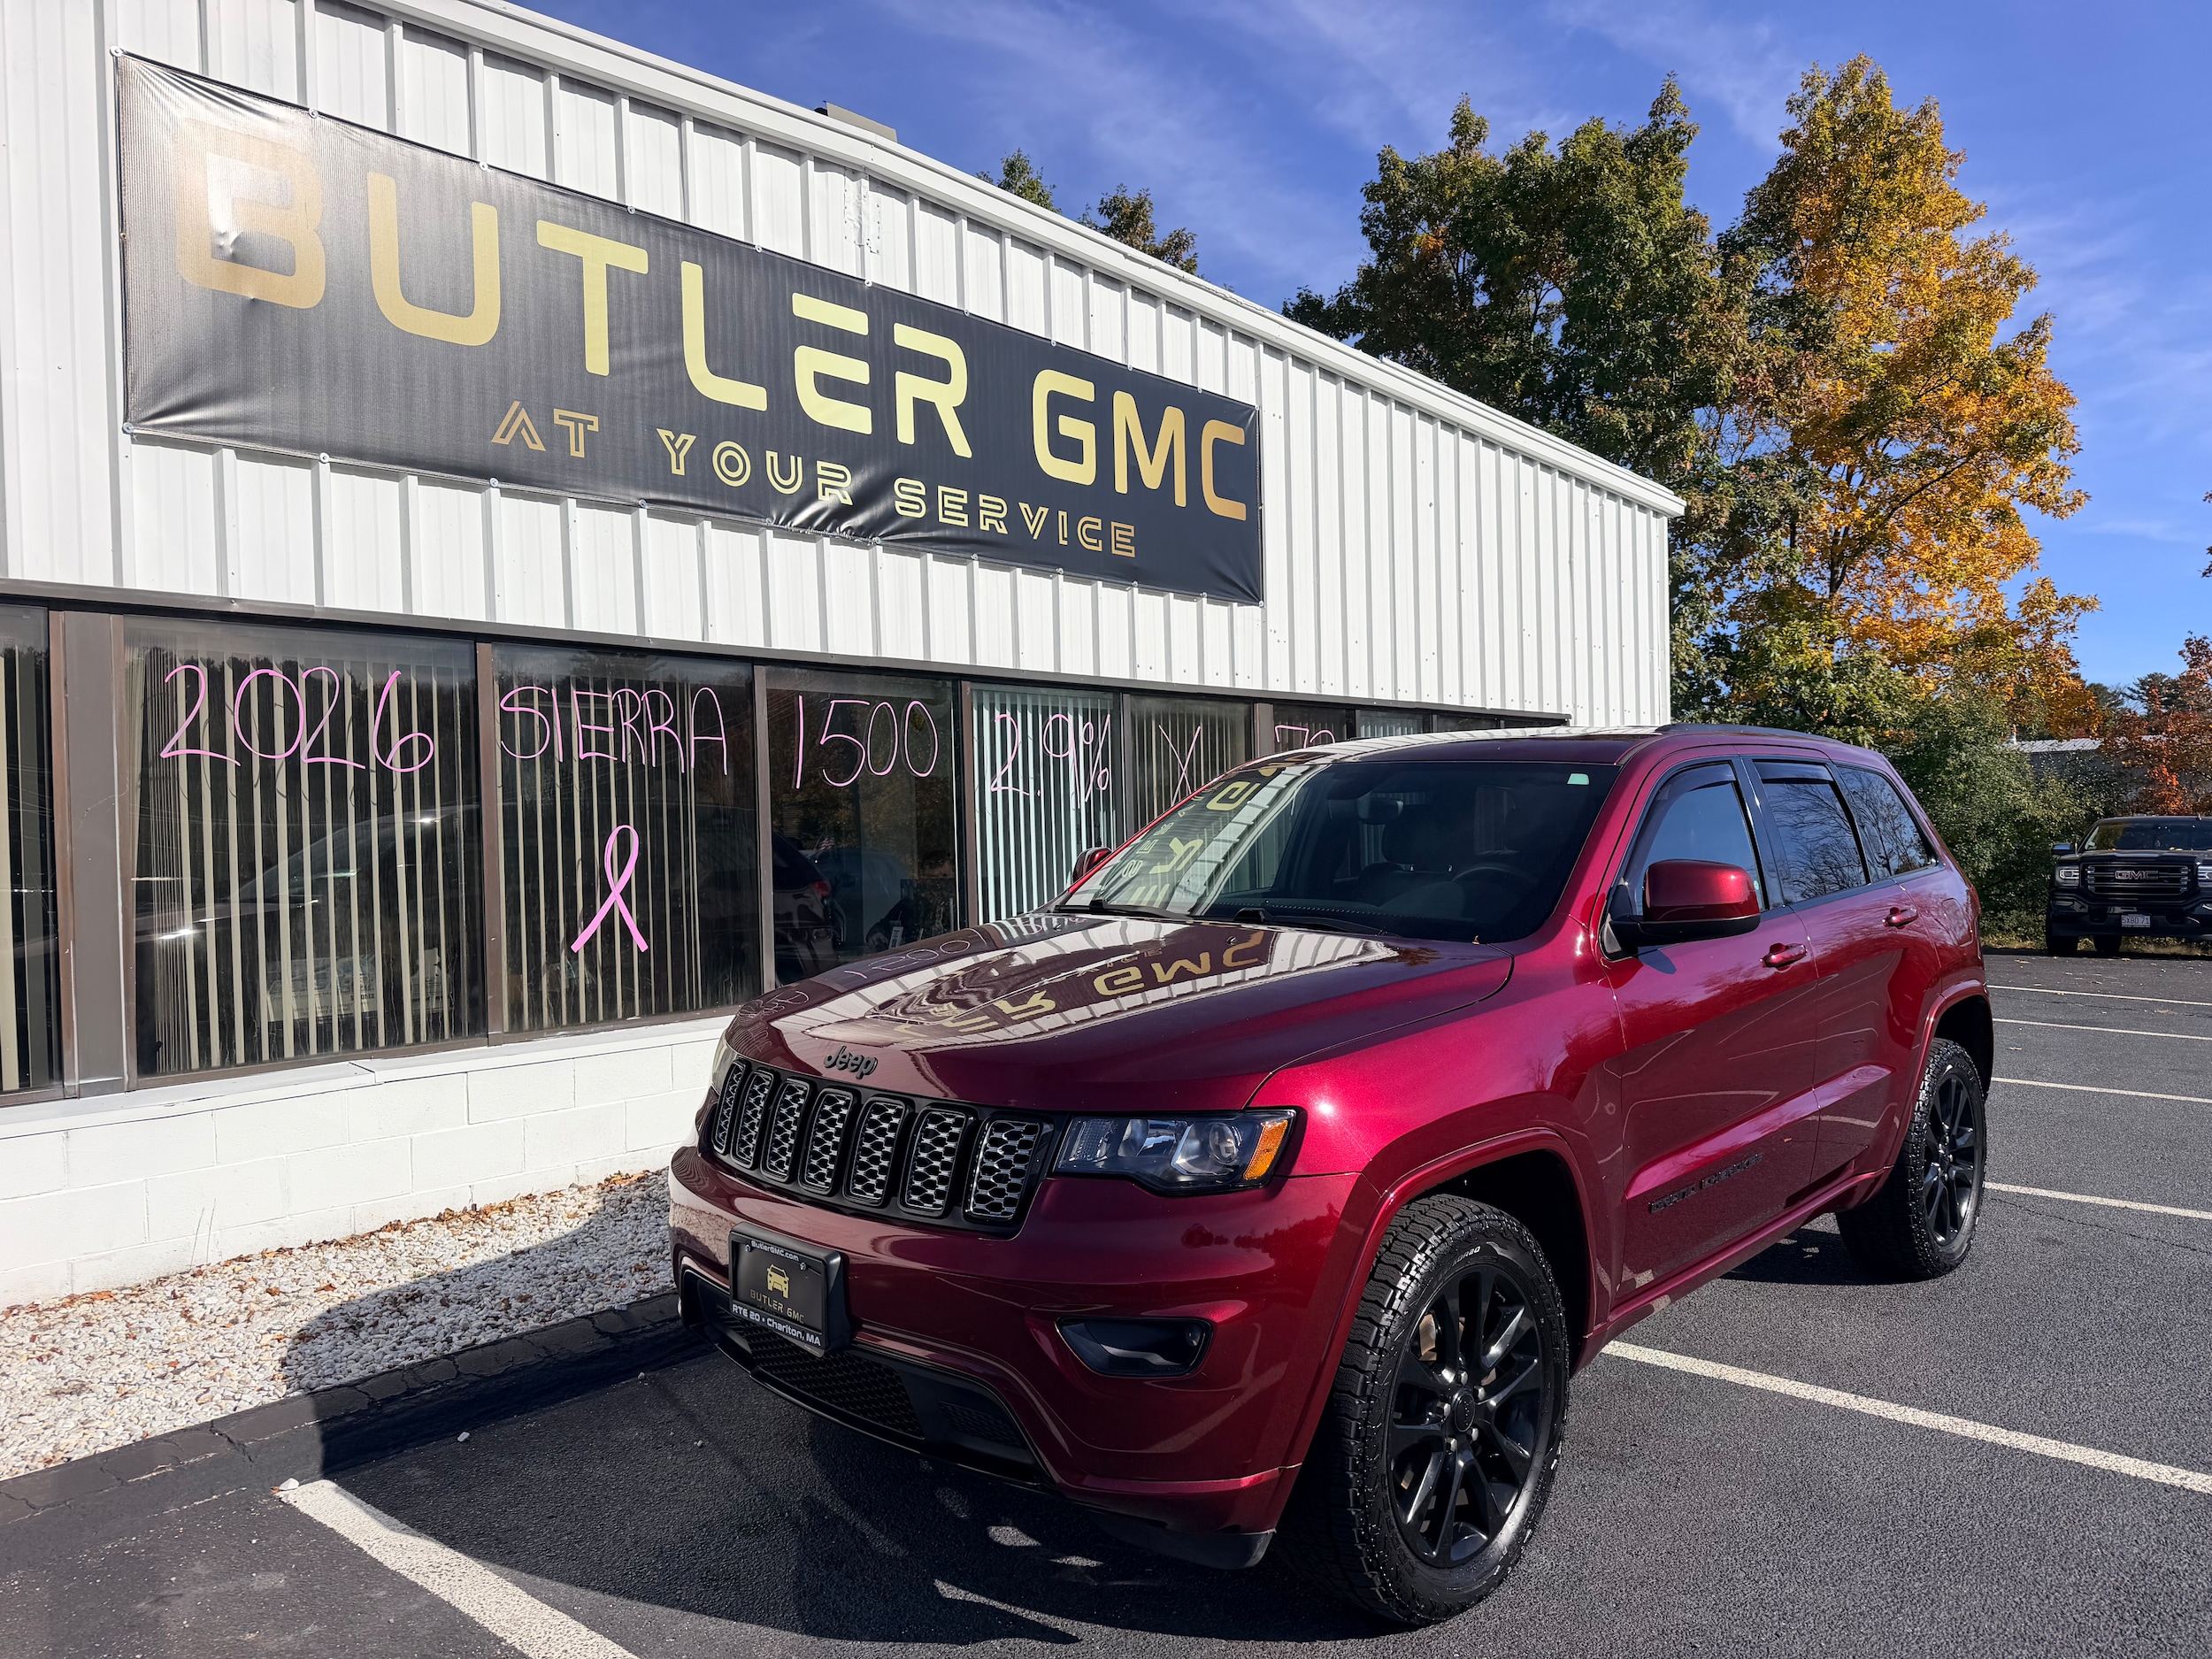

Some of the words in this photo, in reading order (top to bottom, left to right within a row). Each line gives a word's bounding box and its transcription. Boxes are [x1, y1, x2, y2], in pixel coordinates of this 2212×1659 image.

[175, 115, 972, 458] BUTLER
[1032, 368, 1247, 522] GMC
[491, 401, 599, 458] AT
[656, 428, 856, 507] YOUR
[894, 477, 1136, 558] SERVICE
[160, 664, 434, 772] 2026
[499, 685, 728, 776] SIERRA
[791, 694, 939, 789] 1500
[990, 713, 1111, 806] 2.9%
[2115, 870, 2159, 880] GMC
[824, 1045, 879, 1080] Jeep
[751, 1240, 800, 1263] ButlerGMC.com
[732, 1303, 749, 1318] RTE
[749, 1310, 761, 1323] 20
[766, 1317, 805, 1341] Charlton,
[806, 1333, 821, 1347] MA
[749, 1288, 784, 1314] BUTLER
[787, 1308, 805, 1325] GMC
